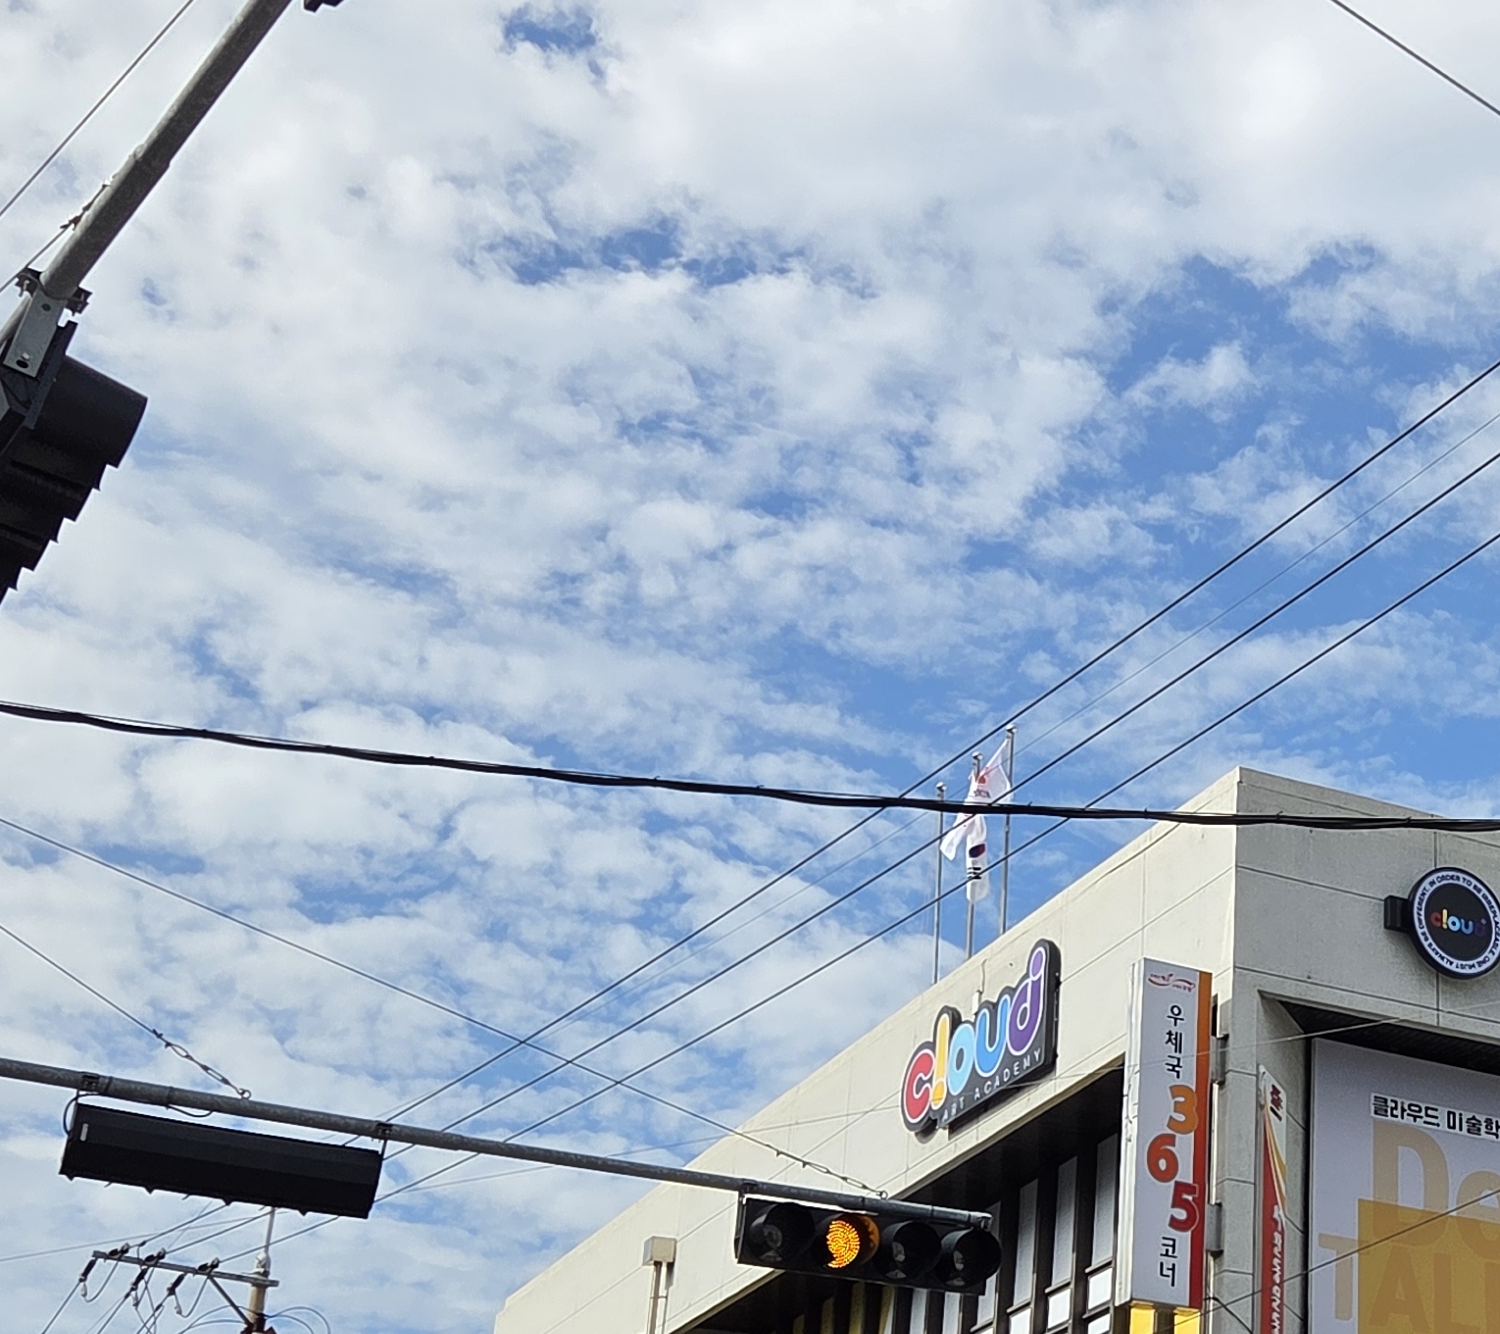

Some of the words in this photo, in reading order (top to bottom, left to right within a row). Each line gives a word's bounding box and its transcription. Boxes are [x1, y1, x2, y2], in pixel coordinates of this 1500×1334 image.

[1165, 1004, 1185, 1079] 우체국
[941, 1098, 965, 1122] ART
[974, 1048, 1041, 1099] ACADEMY
[1372, 1094, 1441, 1128] 클라우드
[1146, 1084, 1198, 1232] 365
[1159, 1235, 1178, 1287] 코너
